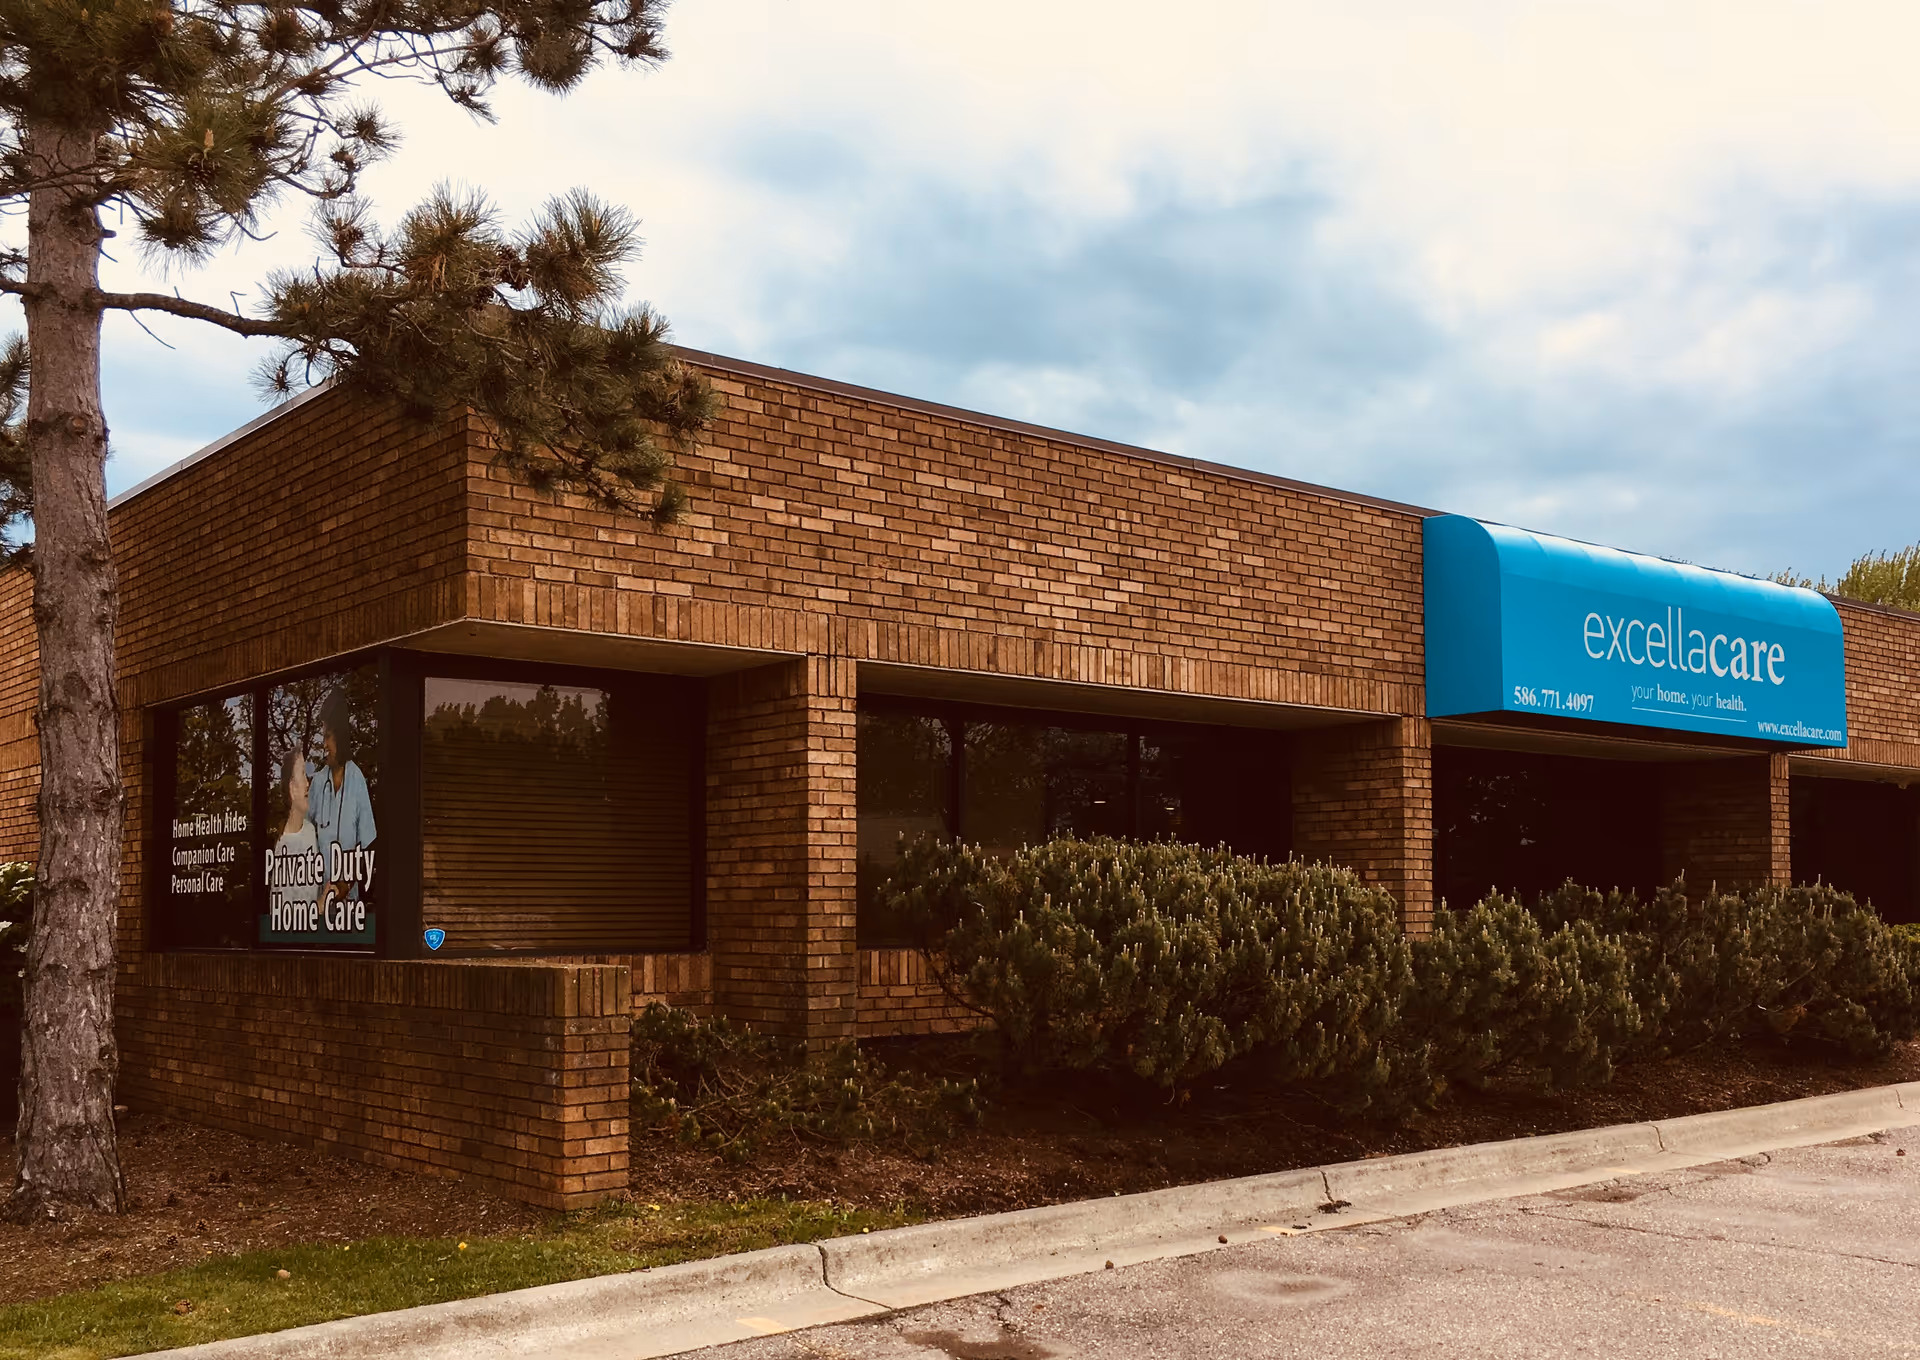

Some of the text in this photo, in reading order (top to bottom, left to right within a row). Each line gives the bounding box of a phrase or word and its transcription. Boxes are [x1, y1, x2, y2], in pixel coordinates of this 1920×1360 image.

[1583, 606, 1786, 685] excellacare
[1513, 685, 1594, 712] 586.771.4097
[1631, 684, 1655, 701] your
[1691, 691, 1713, 710] your
[1715, 692, 1747, 712] health.
[1757, 720, 1842, 742] www.excellacare.com
[172, 811, 248, 839] Home Health Aides
[172, 842, 235, 869] Companion Care
[264, 842, 375, 892] Private Duty
[171, 872, 224, 894] Personal Care
[270, 892, 365, 931] Home Care
